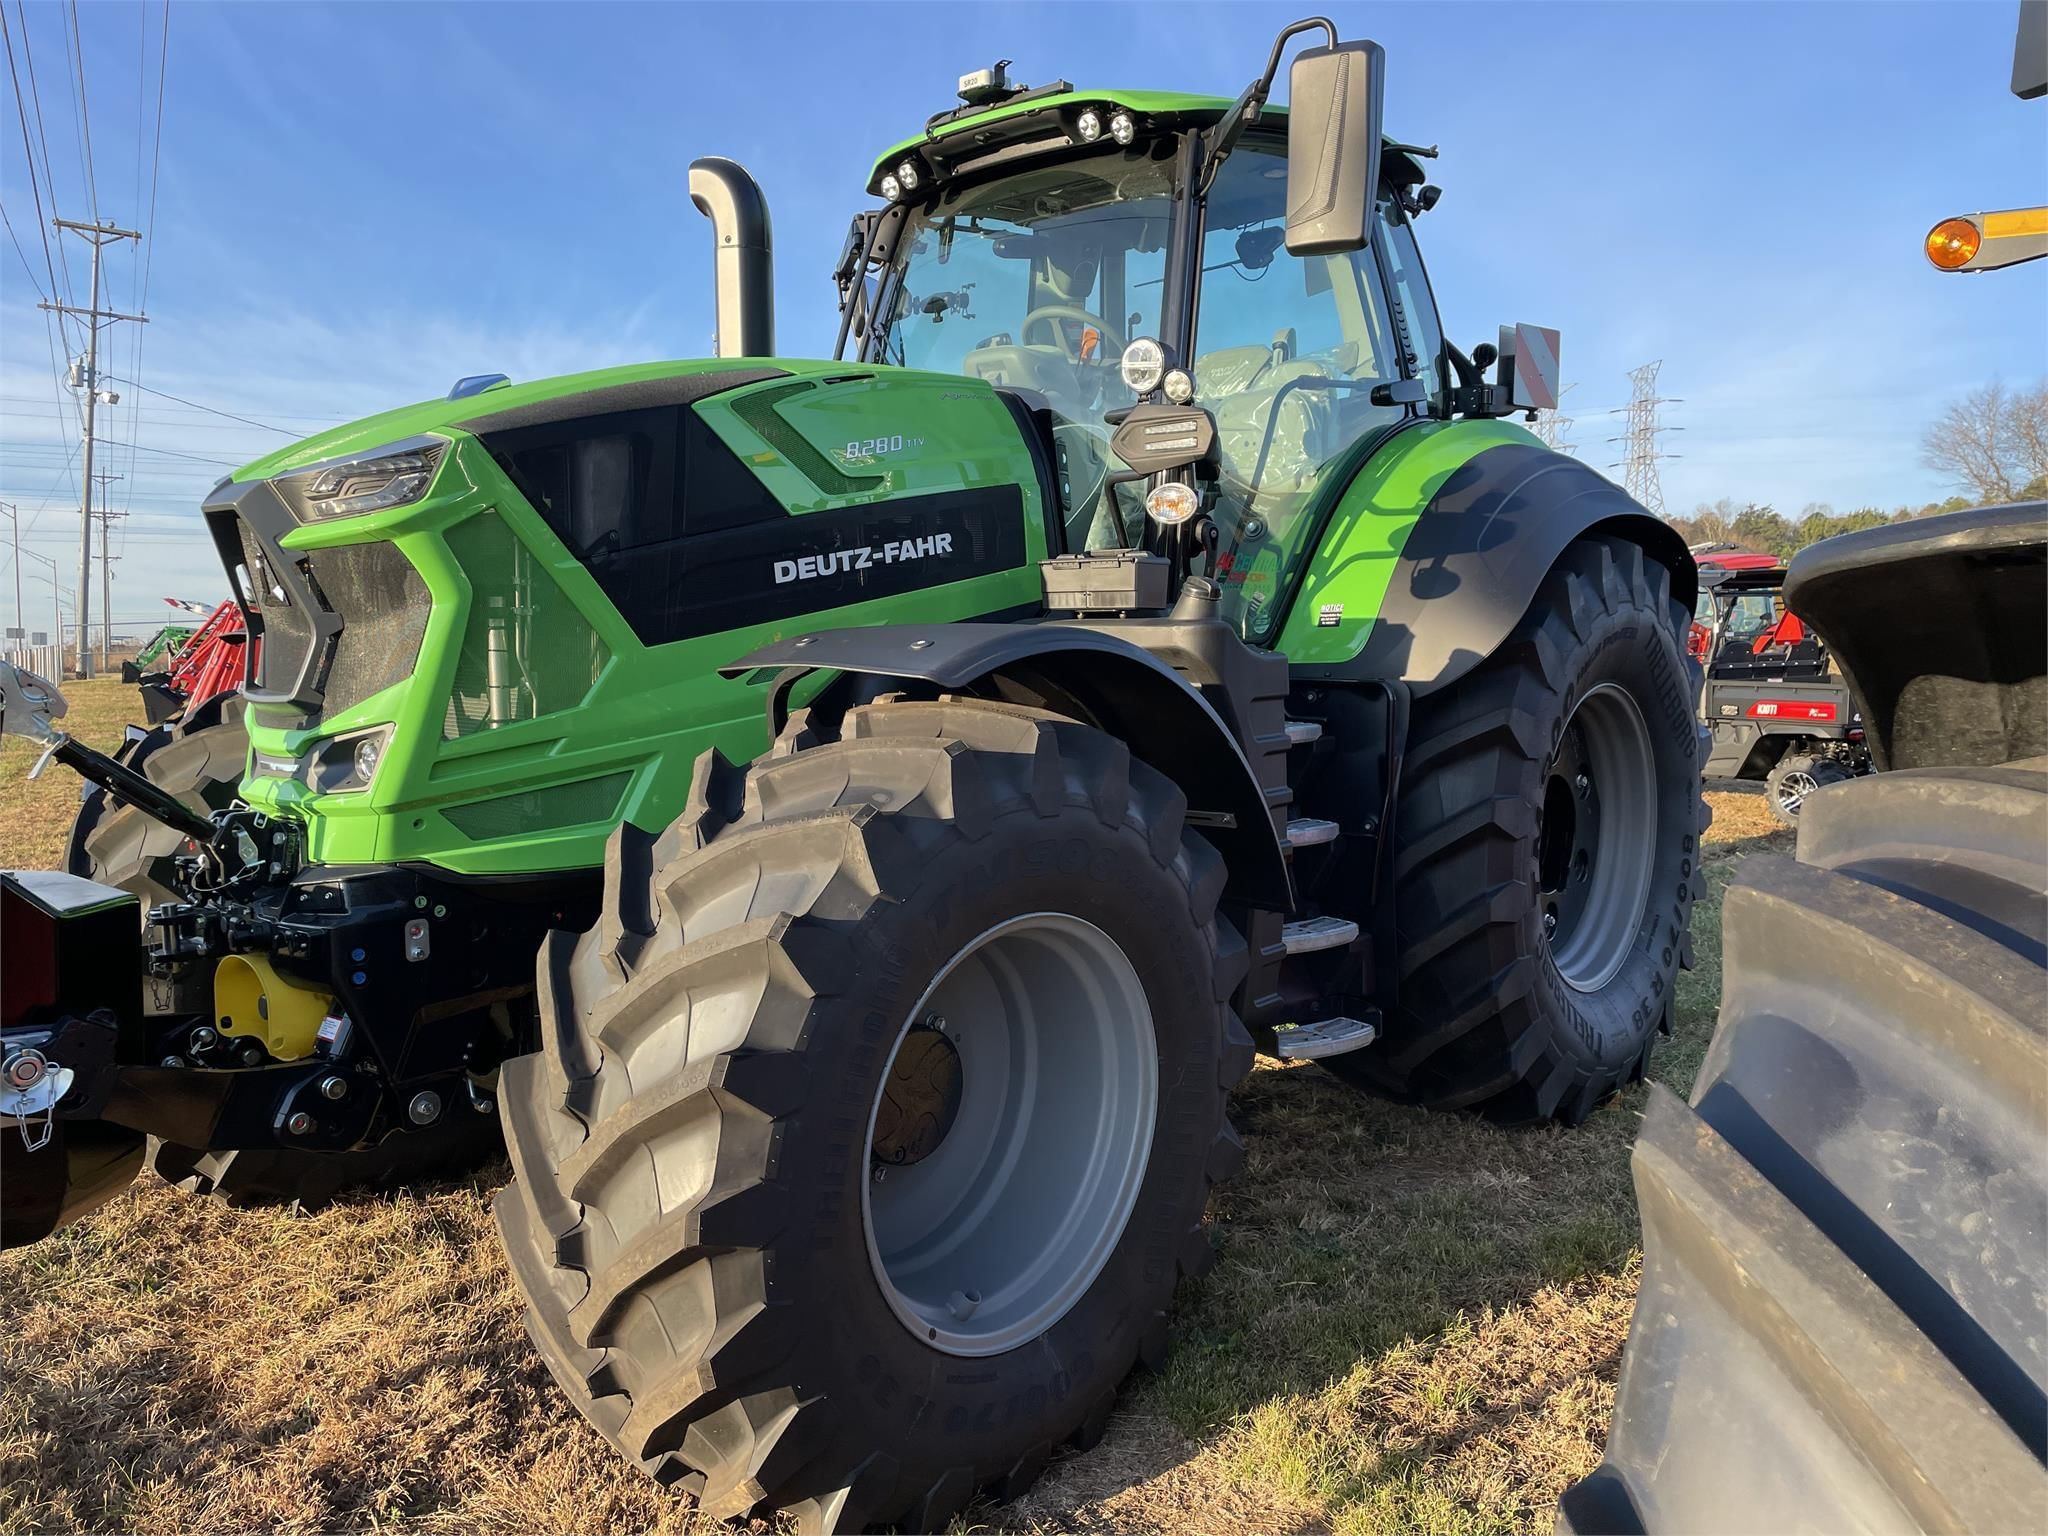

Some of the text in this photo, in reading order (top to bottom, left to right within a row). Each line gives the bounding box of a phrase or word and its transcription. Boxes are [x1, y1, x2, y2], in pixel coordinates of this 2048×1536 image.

[846, 435, 902, 459] 8.280
[773, 532, 953, 584] DEUTZ-FAHR
[1645, 623, 1696, 759] TRELLEBORG
